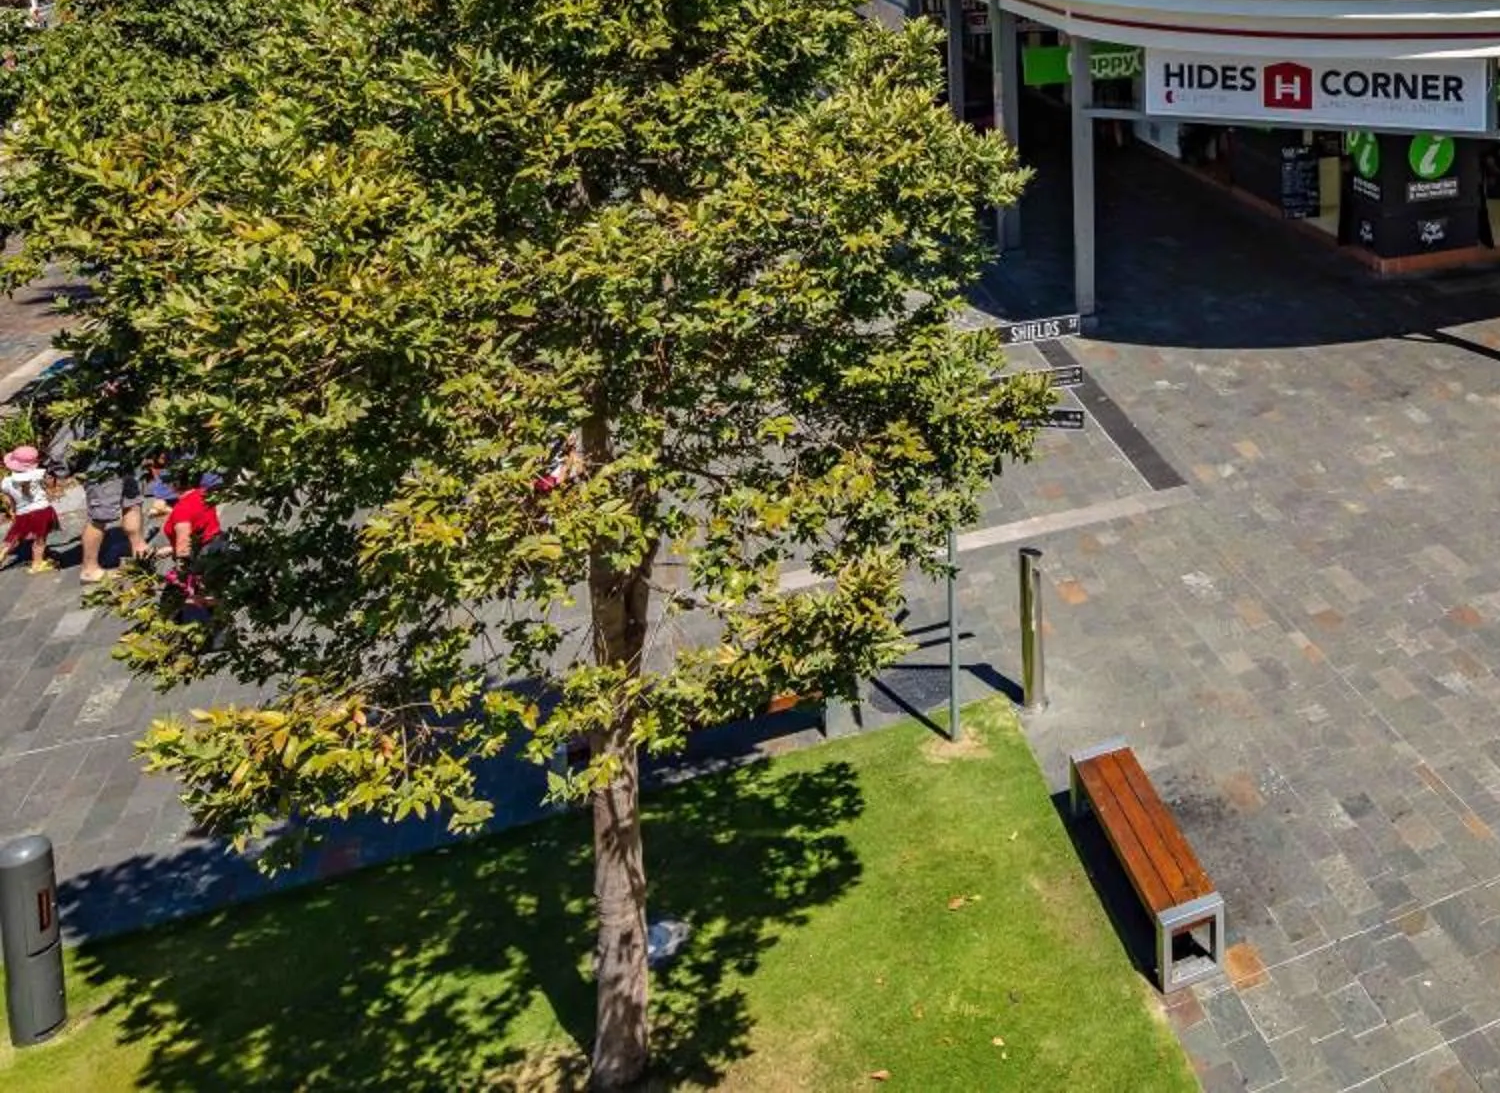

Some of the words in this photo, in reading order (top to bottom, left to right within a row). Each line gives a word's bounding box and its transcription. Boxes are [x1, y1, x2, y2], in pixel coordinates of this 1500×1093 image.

[1163, 62, 1257, 92] HIDES
[1319, 69, 1464, 102] CORNER
[1011, 320, 1060, 342] SHIELDS
